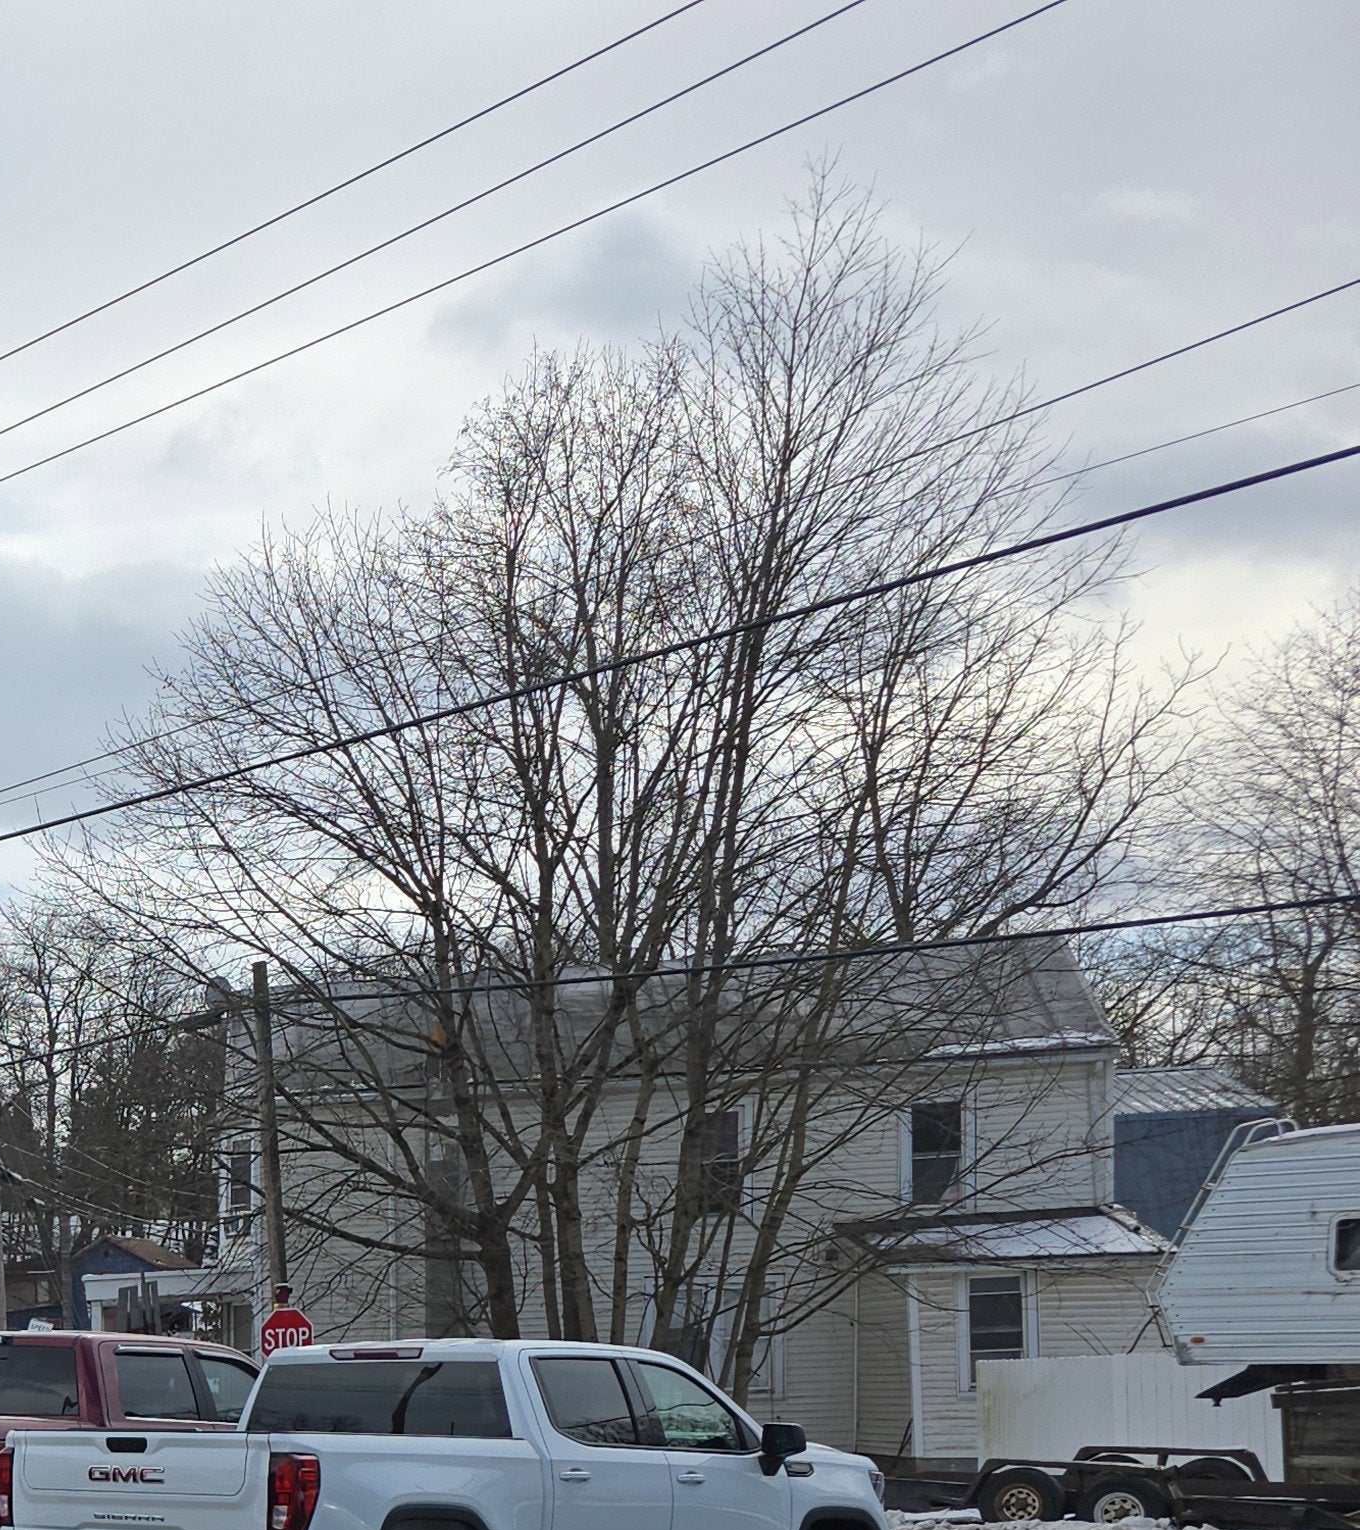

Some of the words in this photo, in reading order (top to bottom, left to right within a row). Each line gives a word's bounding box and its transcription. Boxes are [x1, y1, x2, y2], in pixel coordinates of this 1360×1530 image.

[264, 1327, 309, 1350] STOP
[88, 1465, 165, 1484] GMC
[93, 1512, 165, 1522] SIERRA
